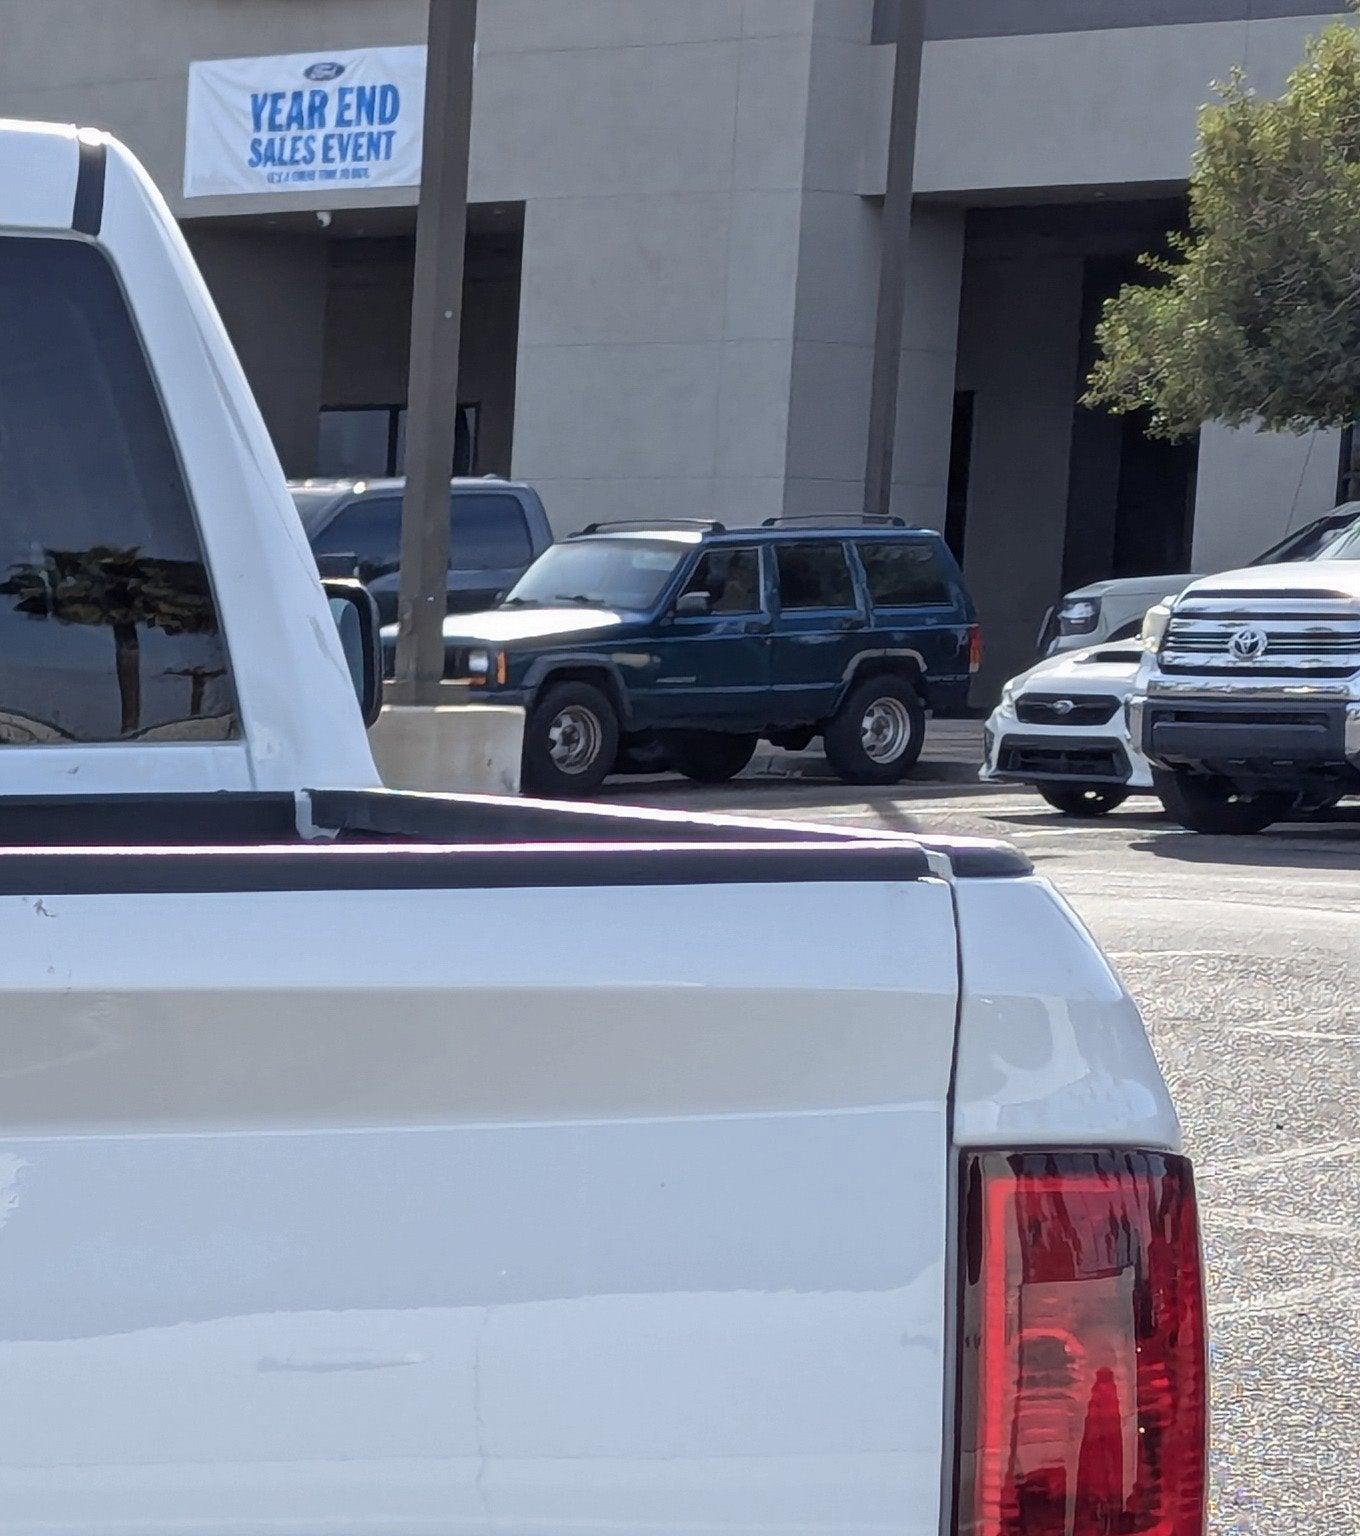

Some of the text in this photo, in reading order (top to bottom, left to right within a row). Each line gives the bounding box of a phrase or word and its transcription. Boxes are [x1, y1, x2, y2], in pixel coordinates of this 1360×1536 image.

[251, 84, 400, 132] YEAR END
[248, 131, 396, 168] SALES EVENT
